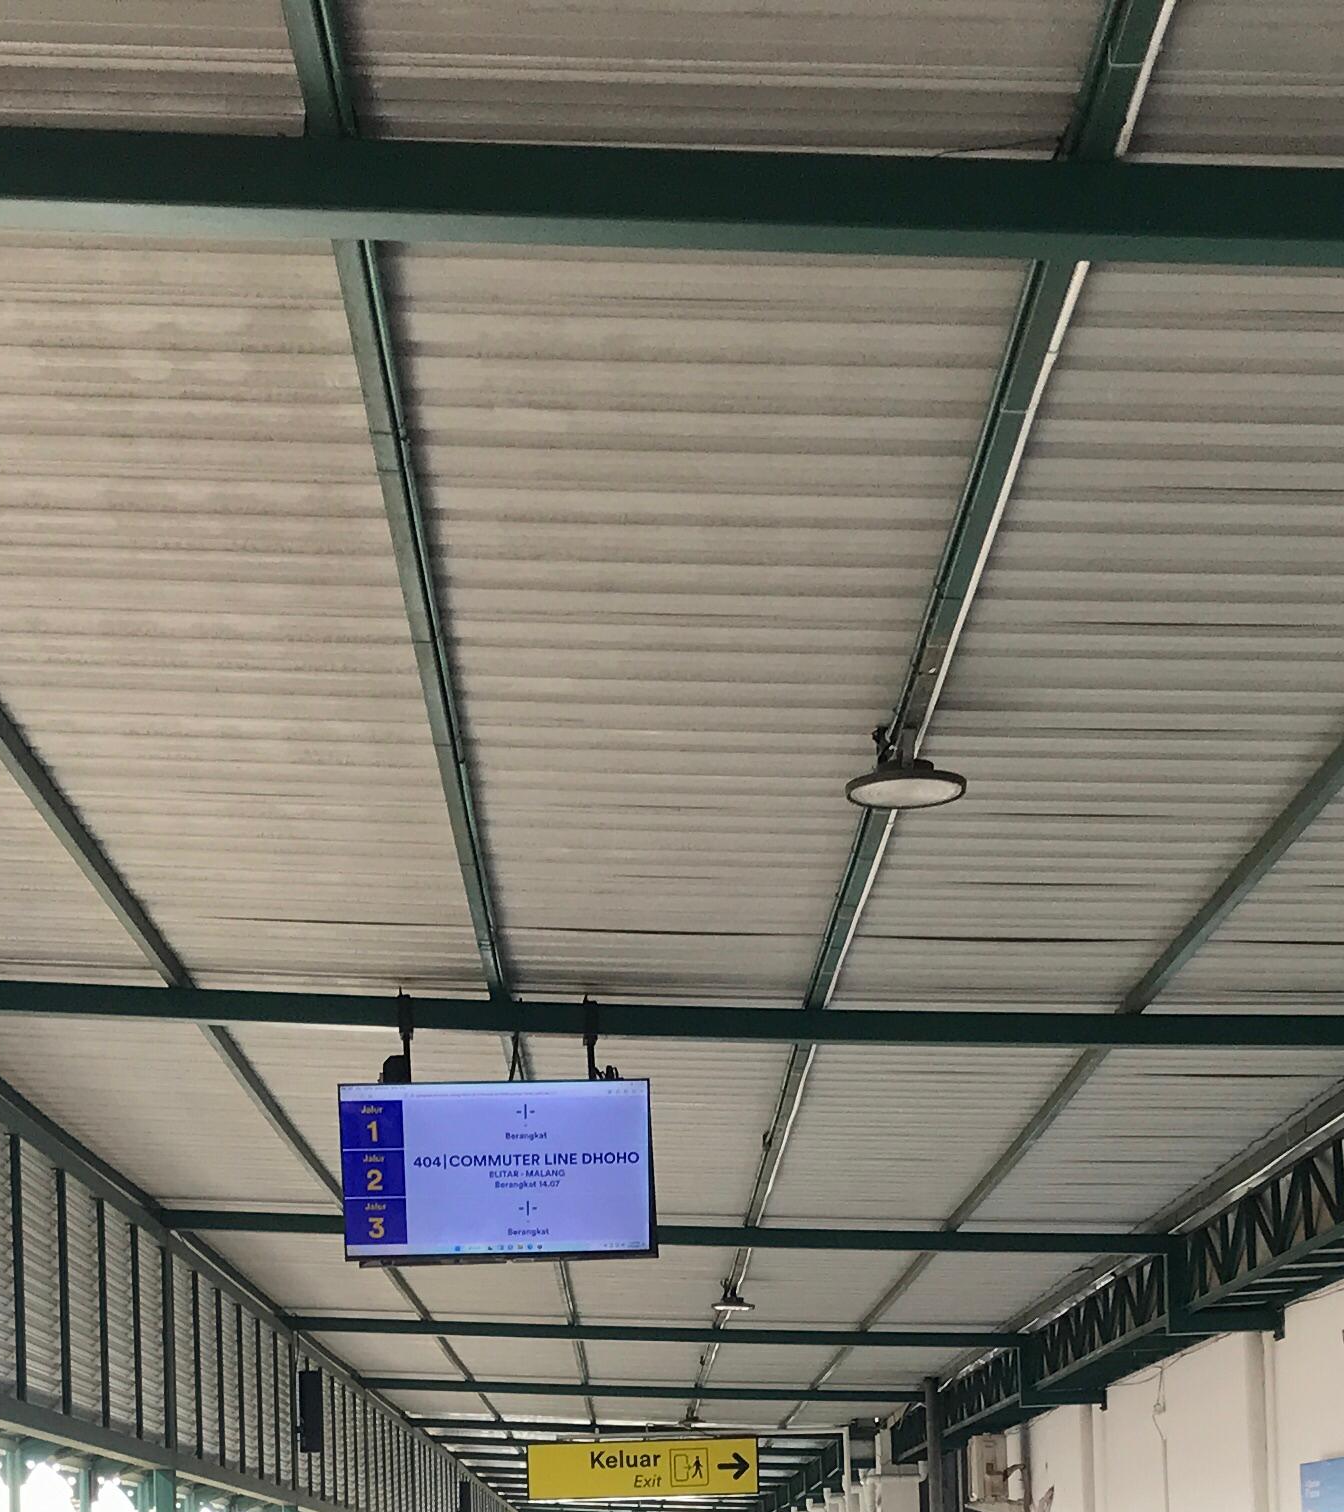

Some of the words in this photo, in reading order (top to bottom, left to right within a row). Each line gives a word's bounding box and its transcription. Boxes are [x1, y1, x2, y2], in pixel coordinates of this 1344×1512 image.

[360, 1104, 384, 1115] Jalur
[366, 1120, 379, 1143] 1
[505, 1131, 548, 1141] Berangkat
[362, 1153, 385, 1163] Jalur
[544, 1152, 578, 1166] LINE
[581, 1151, 640, 1166] DHOHO
[488, 1170, 519, 1179] BLITAR
[525, 1168, 566, 1178] MALANG
[366, 1169, 384, 1191] 2
[494, 1180, 537, 1190] Berangkat
[364, 1202, 387, 1212] Jalur
[368, 1217, 385, 1239] 3
[507, 1227, 550, 1237] Berangkat
[589, 1450, 661, 1470] Keluar
[633, 1474, 662, 1489] Exit
